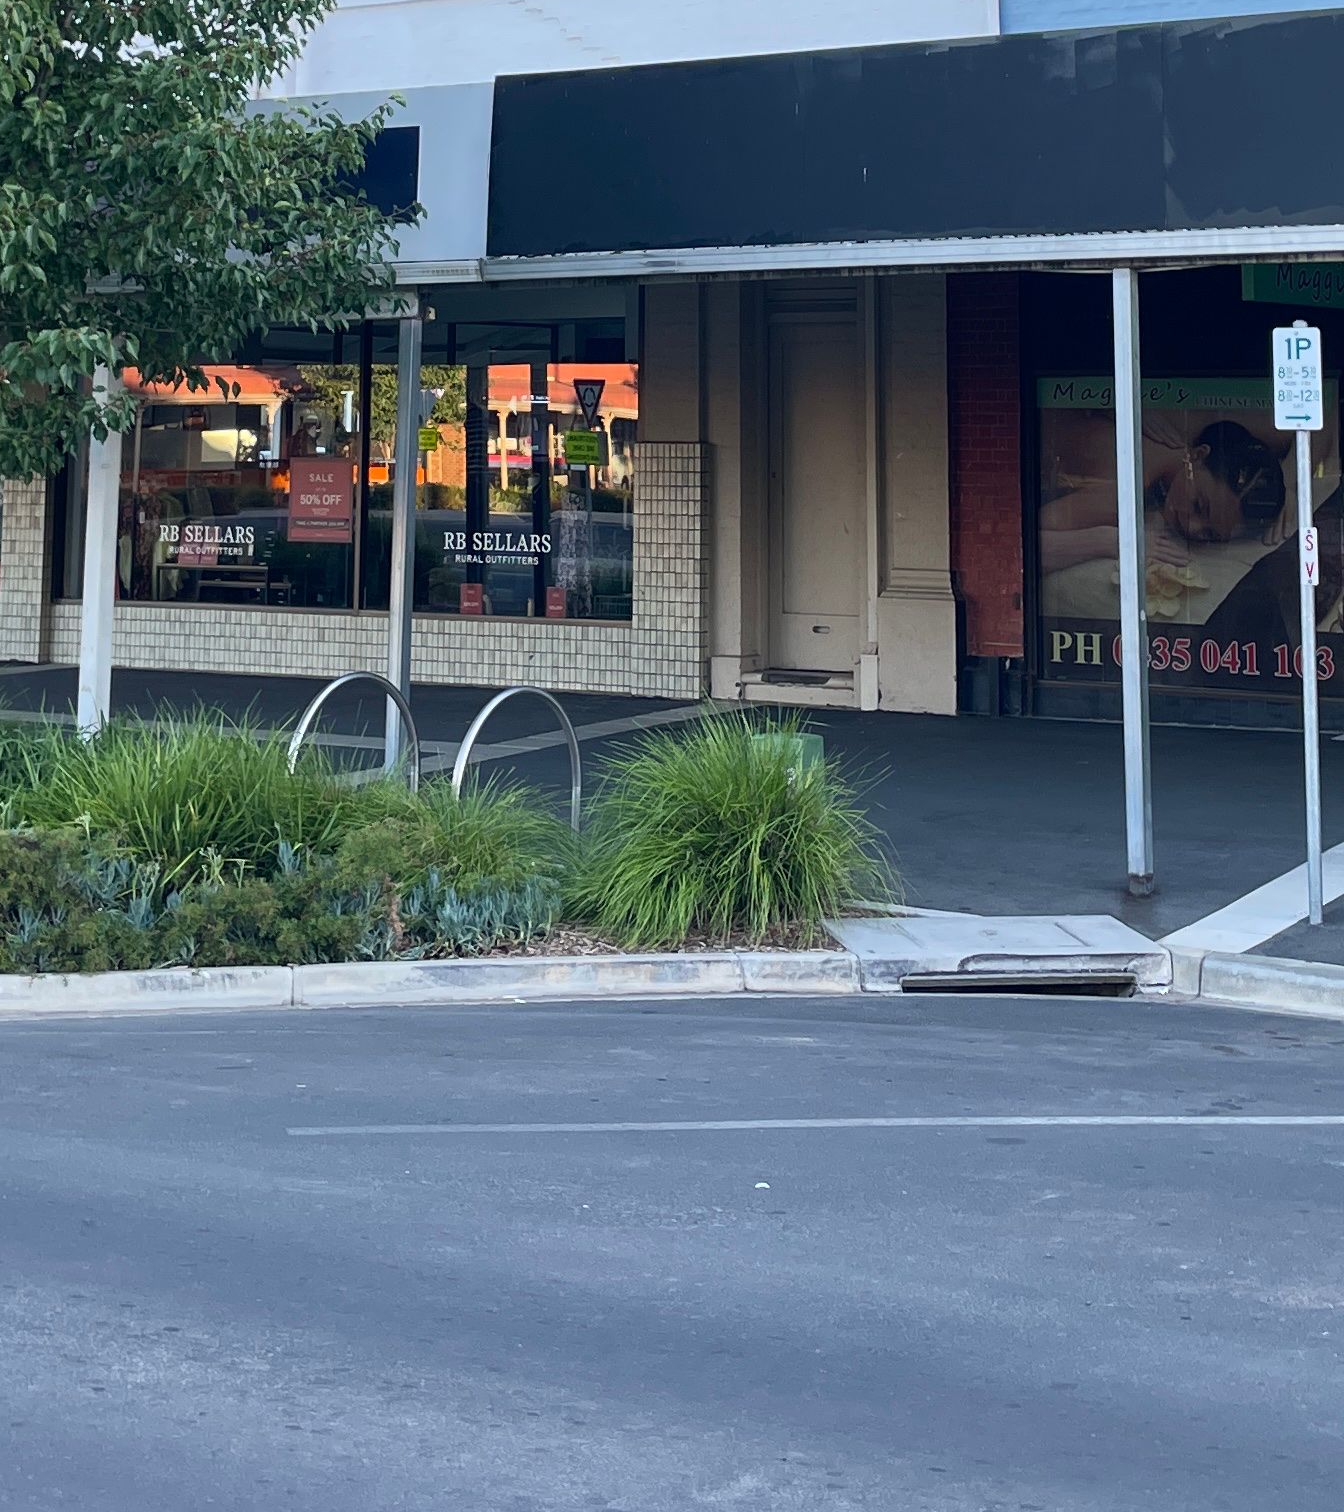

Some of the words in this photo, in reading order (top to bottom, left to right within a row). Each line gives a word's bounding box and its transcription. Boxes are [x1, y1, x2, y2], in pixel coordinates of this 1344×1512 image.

[1285, 337, 1312, 360] 1P
[309, 473, 334, 483] SALE
[299, 494, 321, 505] 50%
[322, 494, 343, 505] OFF
[159, 524, 180, 542] RB
[184, 525, 255, 544] SELLARS
[443, 531, 467, 550] RB
[472, 532, 552, 554] SELLARS
[168, 546, 194, 555] RURAL
[196, 546, 243, 556] OUTFITTERS
[455, 554, 484, 564] RURAL
[485, 554, 539, 566] OUTFITTERS
[1050, 630, 1104, 666] PH
[1200, 639, 1260, 676] 041
